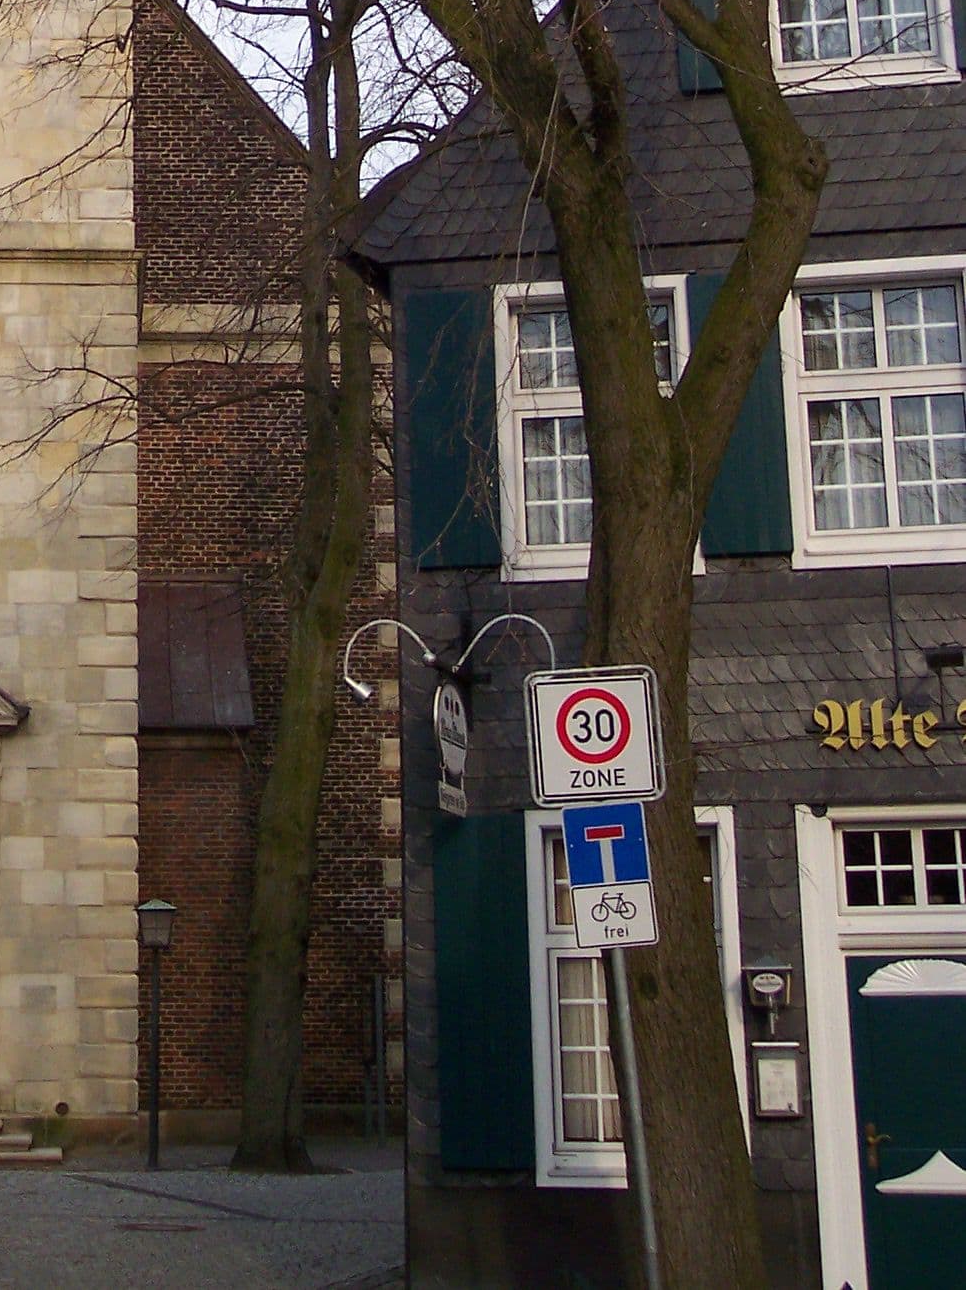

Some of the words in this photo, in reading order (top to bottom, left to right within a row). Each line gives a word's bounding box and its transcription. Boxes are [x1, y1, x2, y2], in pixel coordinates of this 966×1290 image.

[571, 708, 616, 744] 30
[814, 697, 940, 751] Alte
[570, 768, 627, 788] ZONE
[603, 924, 630, 940] frei
